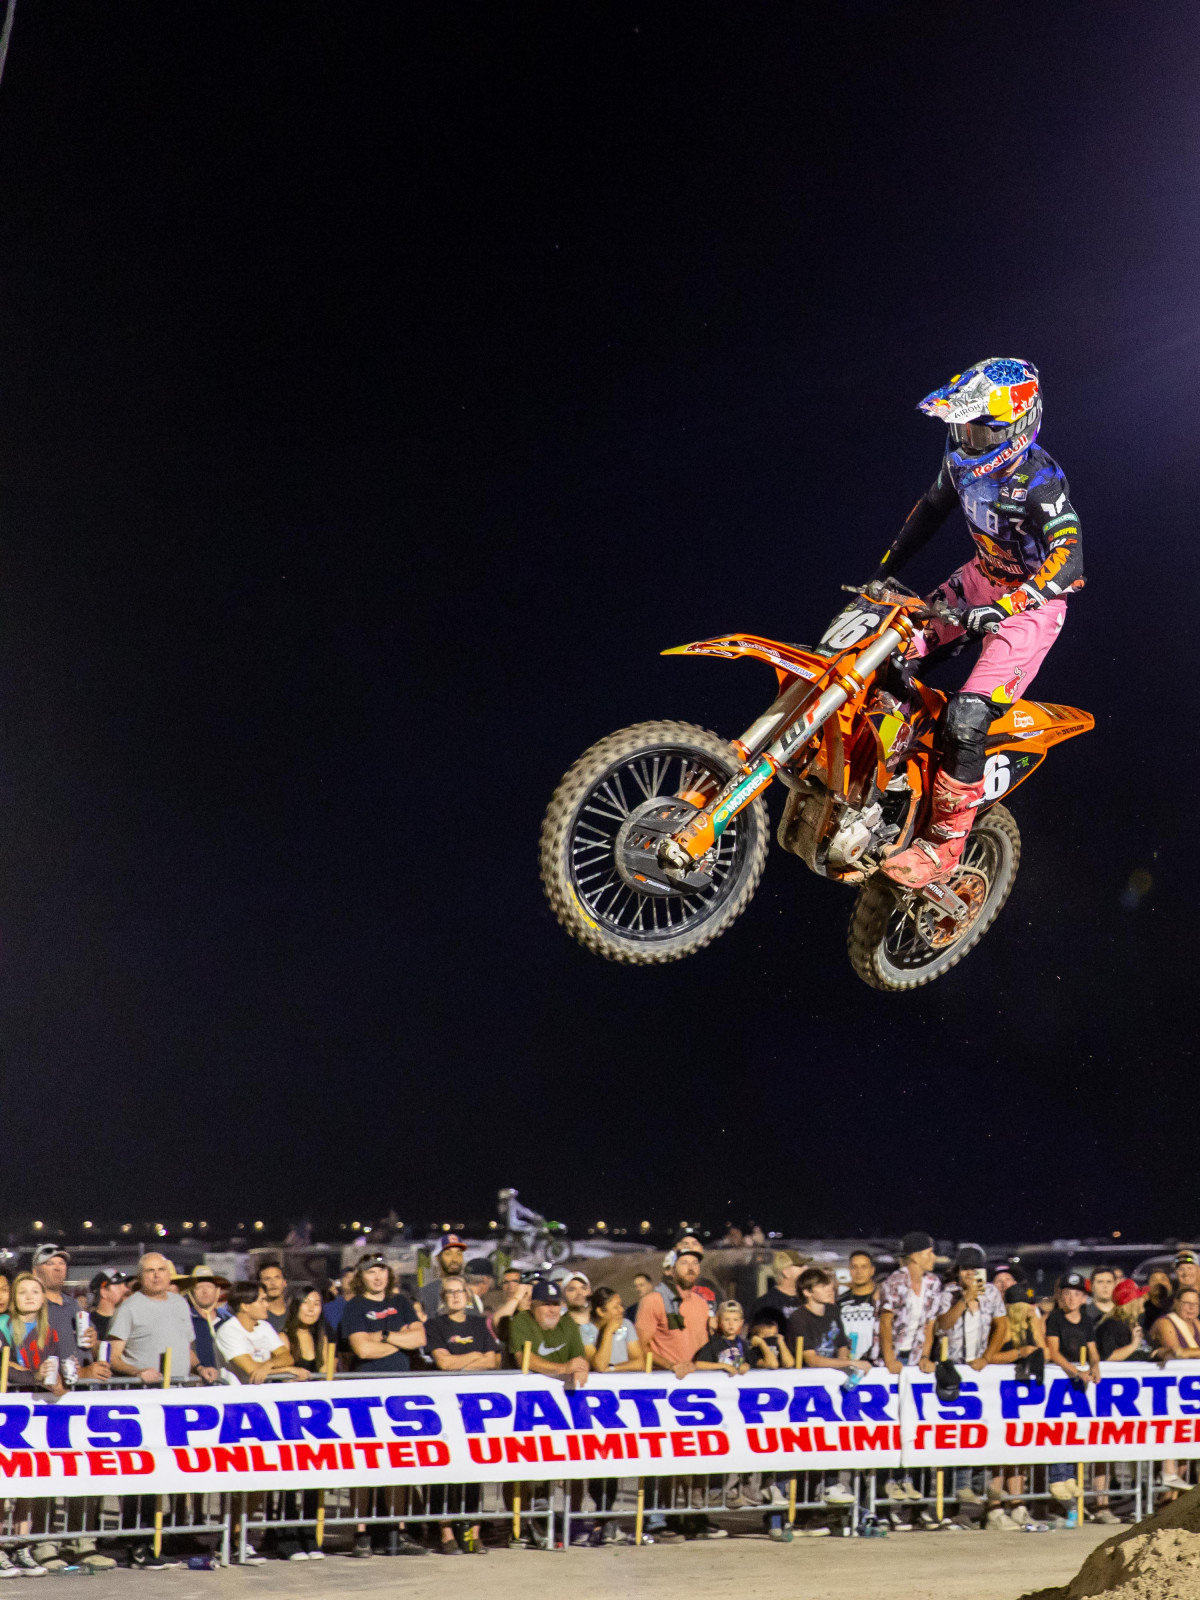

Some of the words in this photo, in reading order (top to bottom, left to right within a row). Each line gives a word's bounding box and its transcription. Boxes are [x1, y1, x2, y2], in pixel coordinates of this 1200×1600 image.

[972, 455, 1003, 477] Red
[1002, 434, 1029, 461] Bull
[1034, 547, 1071, 590] KTM
[820, 609, 881, 650] 16
[778, 659, 814, 679] PROGRESSIVE
[725, 773, 767, 813] MOTOREX
[925, 883, 945, 899] NTHAL
[0, 1405, 143, 1449] RTS
[161, 1395, 443, 1447] PARTS
[456, 1388, 724, 1434] PARTS
[738, 1382, 983, 1425] PARTS
[0, 1450, 155, 1477] MITED
[172, 1440, 451, 1473] UNLIMITED
[467, 1430, 730, 1464] UNLIMITED
[746, 1424, 989, 1454] UNLIMITED
